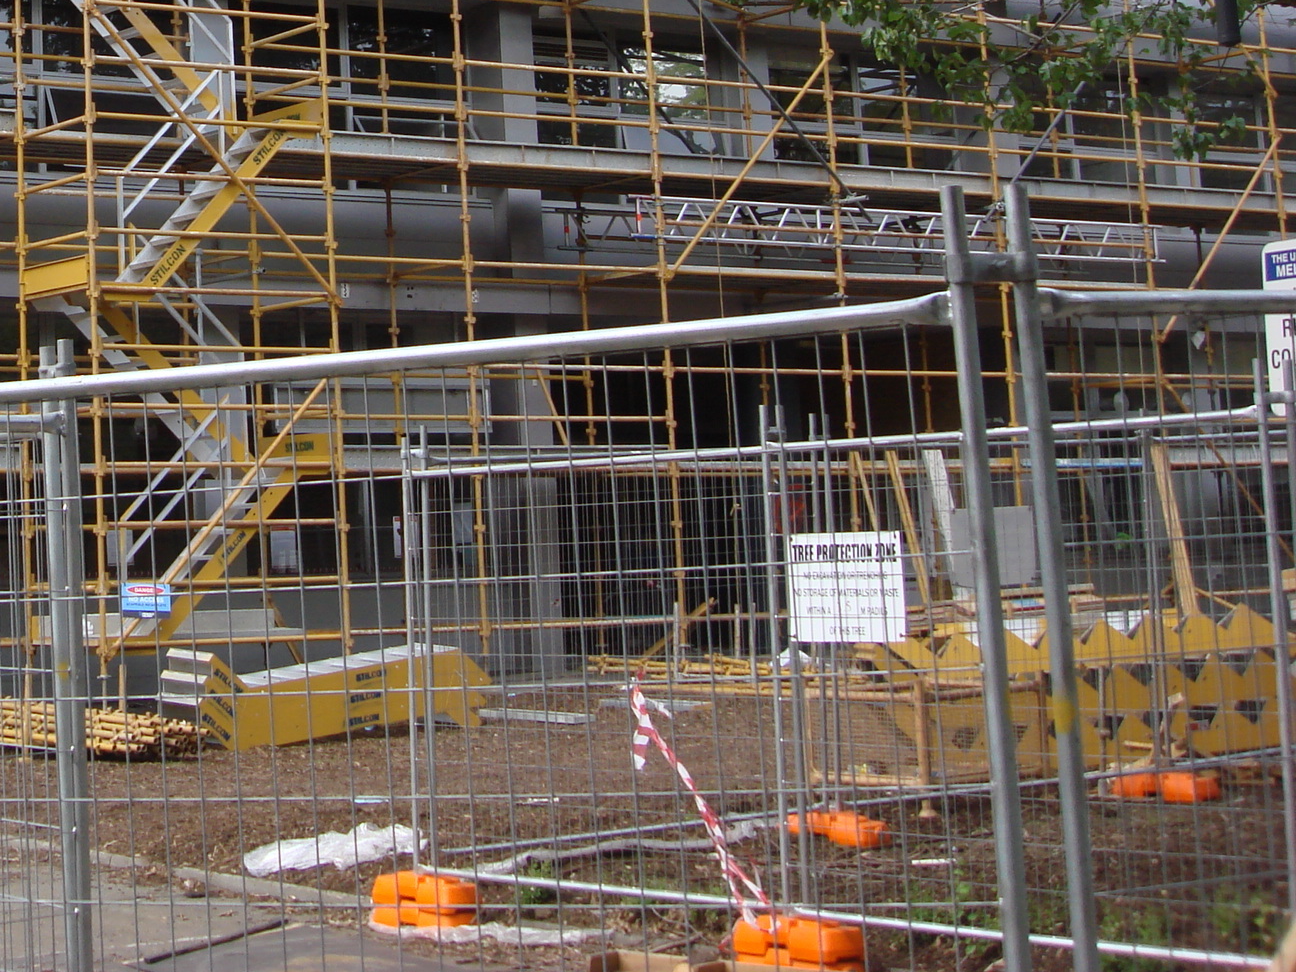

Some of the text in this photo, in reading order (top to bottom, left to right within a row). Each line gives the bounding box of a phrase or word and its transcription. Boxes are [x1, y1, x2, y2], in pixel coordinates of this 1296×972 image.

[150, 244, 186, 285] STILCON
[1271, 253, 1288, 264] THE
[792, 542, 897, 563] TREE PROTECTION ZONE
